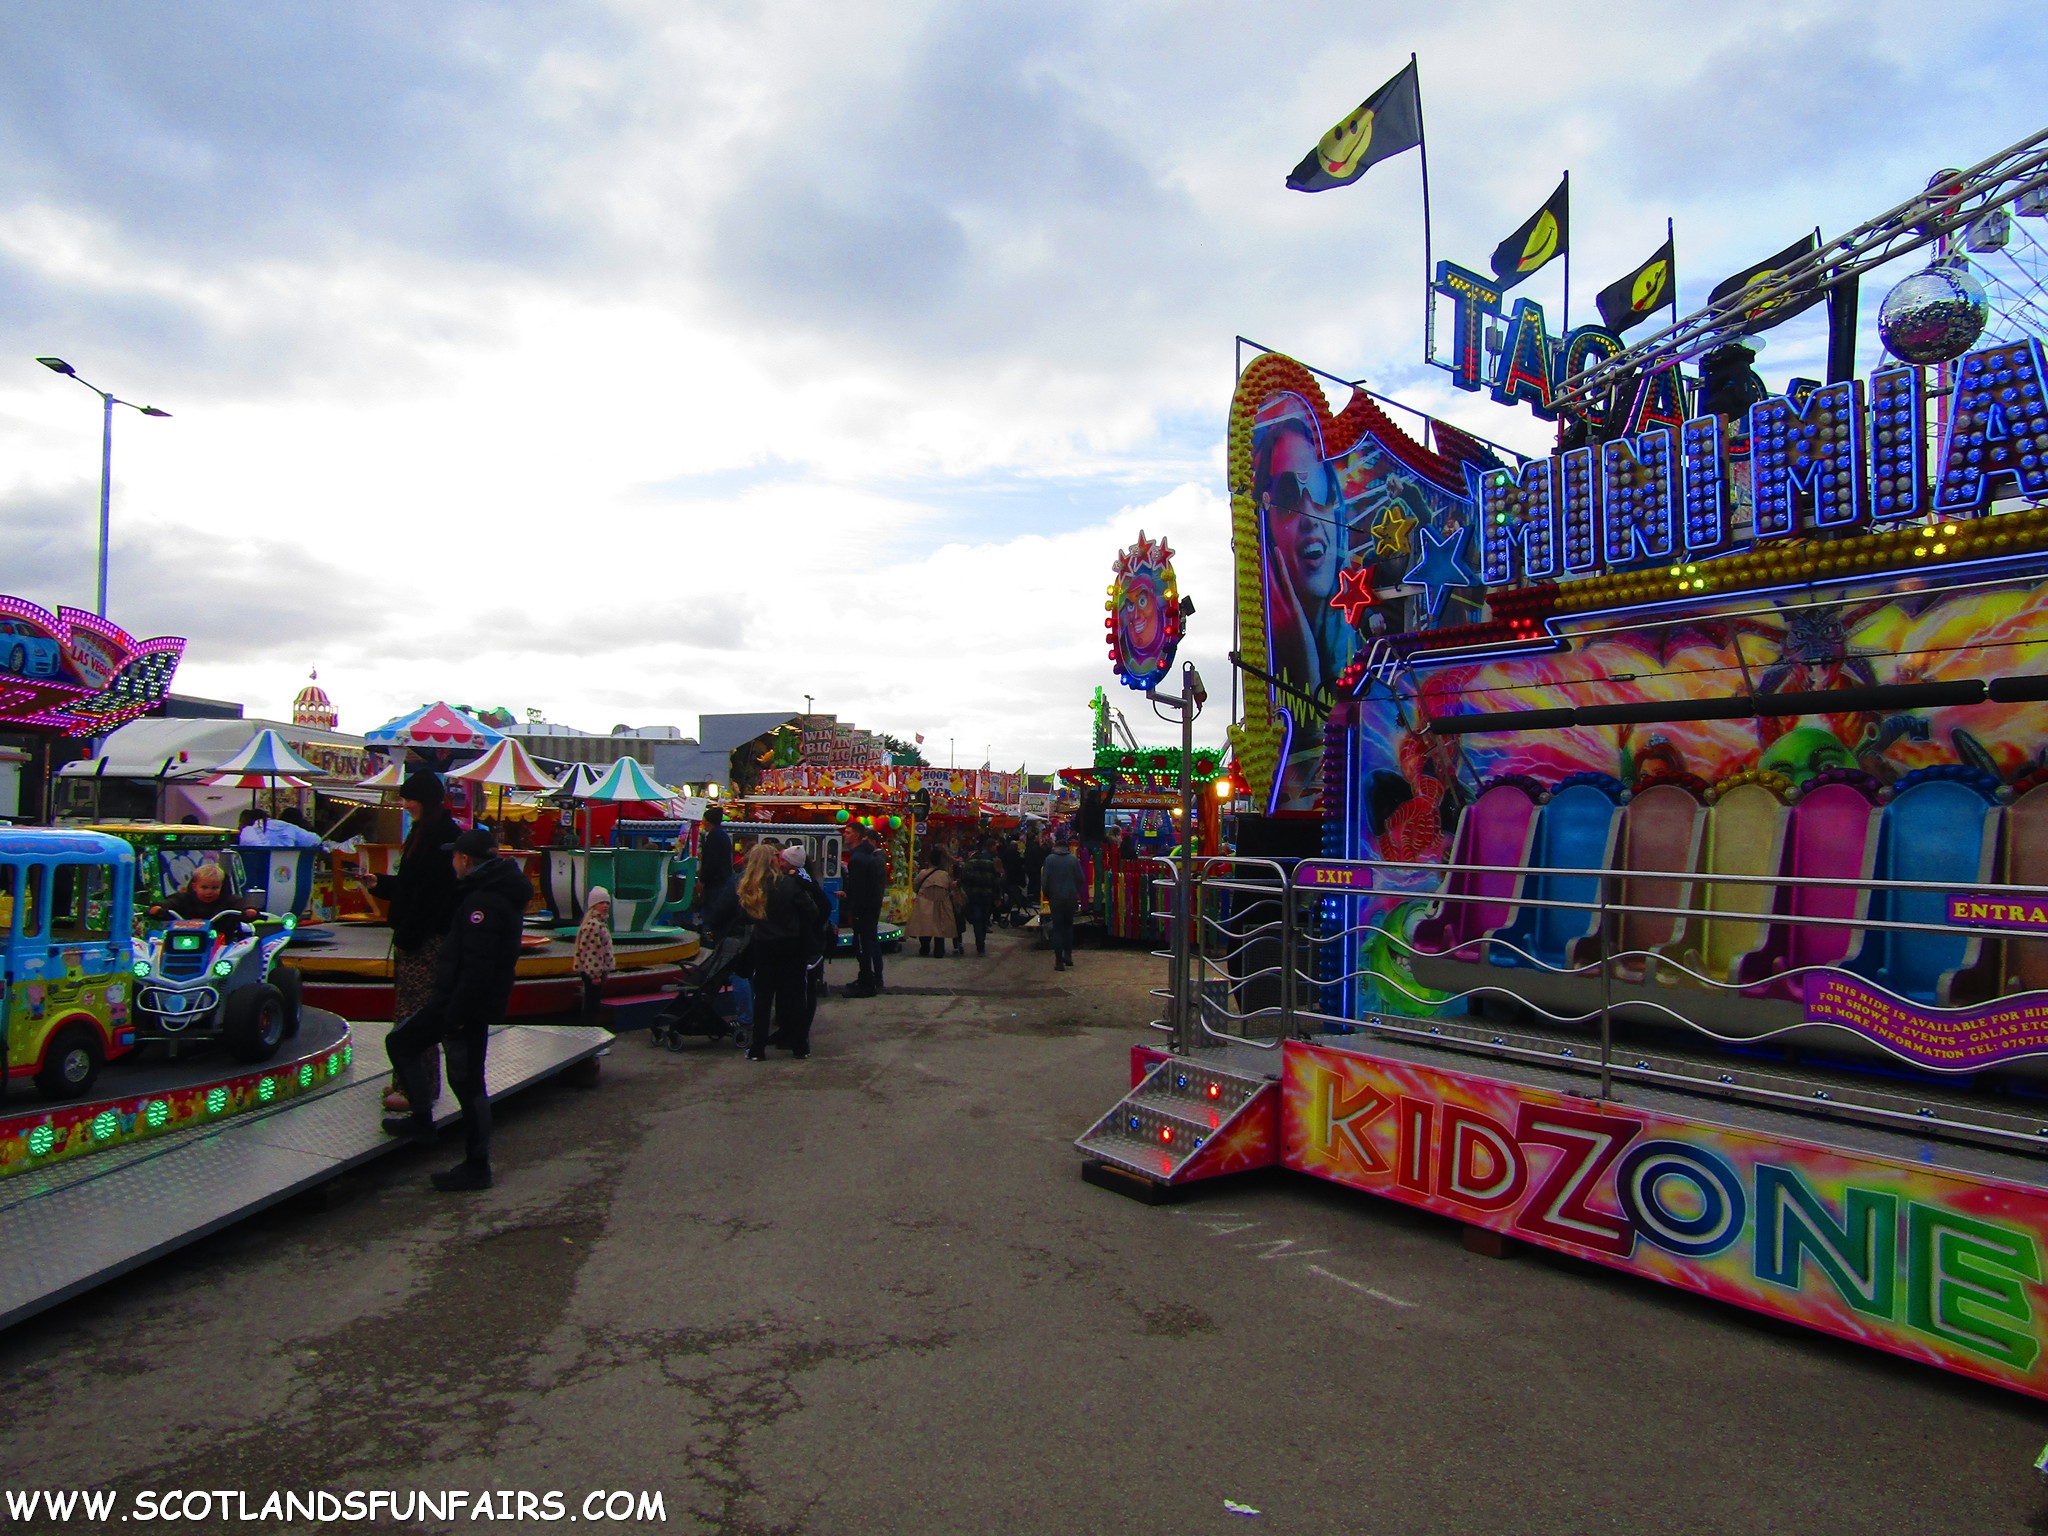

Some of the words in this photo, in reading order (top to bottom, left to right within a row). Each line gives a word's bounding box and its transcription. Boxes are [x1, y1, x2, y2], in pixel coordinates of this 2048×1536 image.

[1479, 413, 1730, 587] MINI
[71, 645, 89, 666] LAS
[805, 730, 833, 741] WIN
[832, 738, 850, 748] IN
[806, 742, 831, 754] BIG
[852, 744, 868, 754] IN
[323, 752, 357, 774] FUN
[835, 769, 860, 780] PRIZE
[923, 771, 949, 780] HOOK
[1316, 869, 1353, 885] EXIT
[1954, 902, 2048, 923] ENTRA
[1828, 981, 1857, 997] THIS
[1859, 992, 1890, 1013] RIDE
[1893, 1009, 1907, 1021] IS
[1909, 1016, 1988, 1033] AVAILABLE
[1991, 1011, 2020, 1024] FOR
[1819, 992, 1842, 1003] FOR
[1846, 999, 1889, 1025] SHOWS
[1902, 1026, 1956, 1046] EVENTS
[1969, 1024, 2018, 1042] GALAS
[2021, 1020, 2048, 1032] ETC
[1810, 1004, 1832, 1013] FOR
[1836, 1007, 1870, 1027] MORE
[1873, 1023, 1964, 1059] INFORMATION
[1968, 1043, 1998, 1056] TEL:
[1314, 1066, 2043, 1373] KIDZONE
